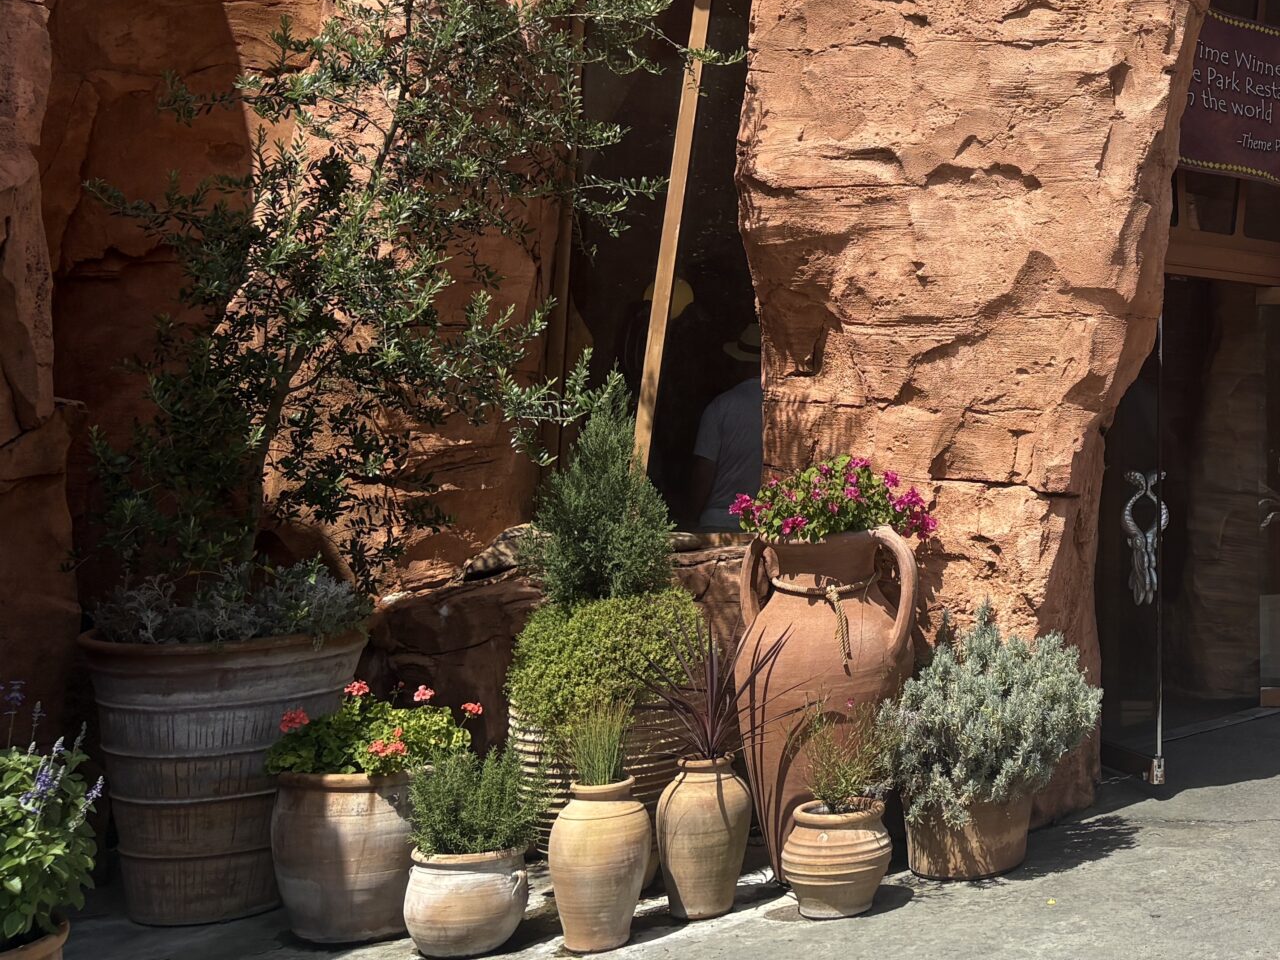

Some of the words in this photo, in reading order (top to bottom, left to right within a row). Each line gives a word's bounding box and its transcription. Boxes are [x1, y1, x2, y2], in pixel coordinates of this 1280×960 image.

[1197, 39, 1229, 65] ime
[1207, 67, 1240, 92] Park
[1201, 87, 1227, 113] the
[1231, 99, 1273, 124] world
